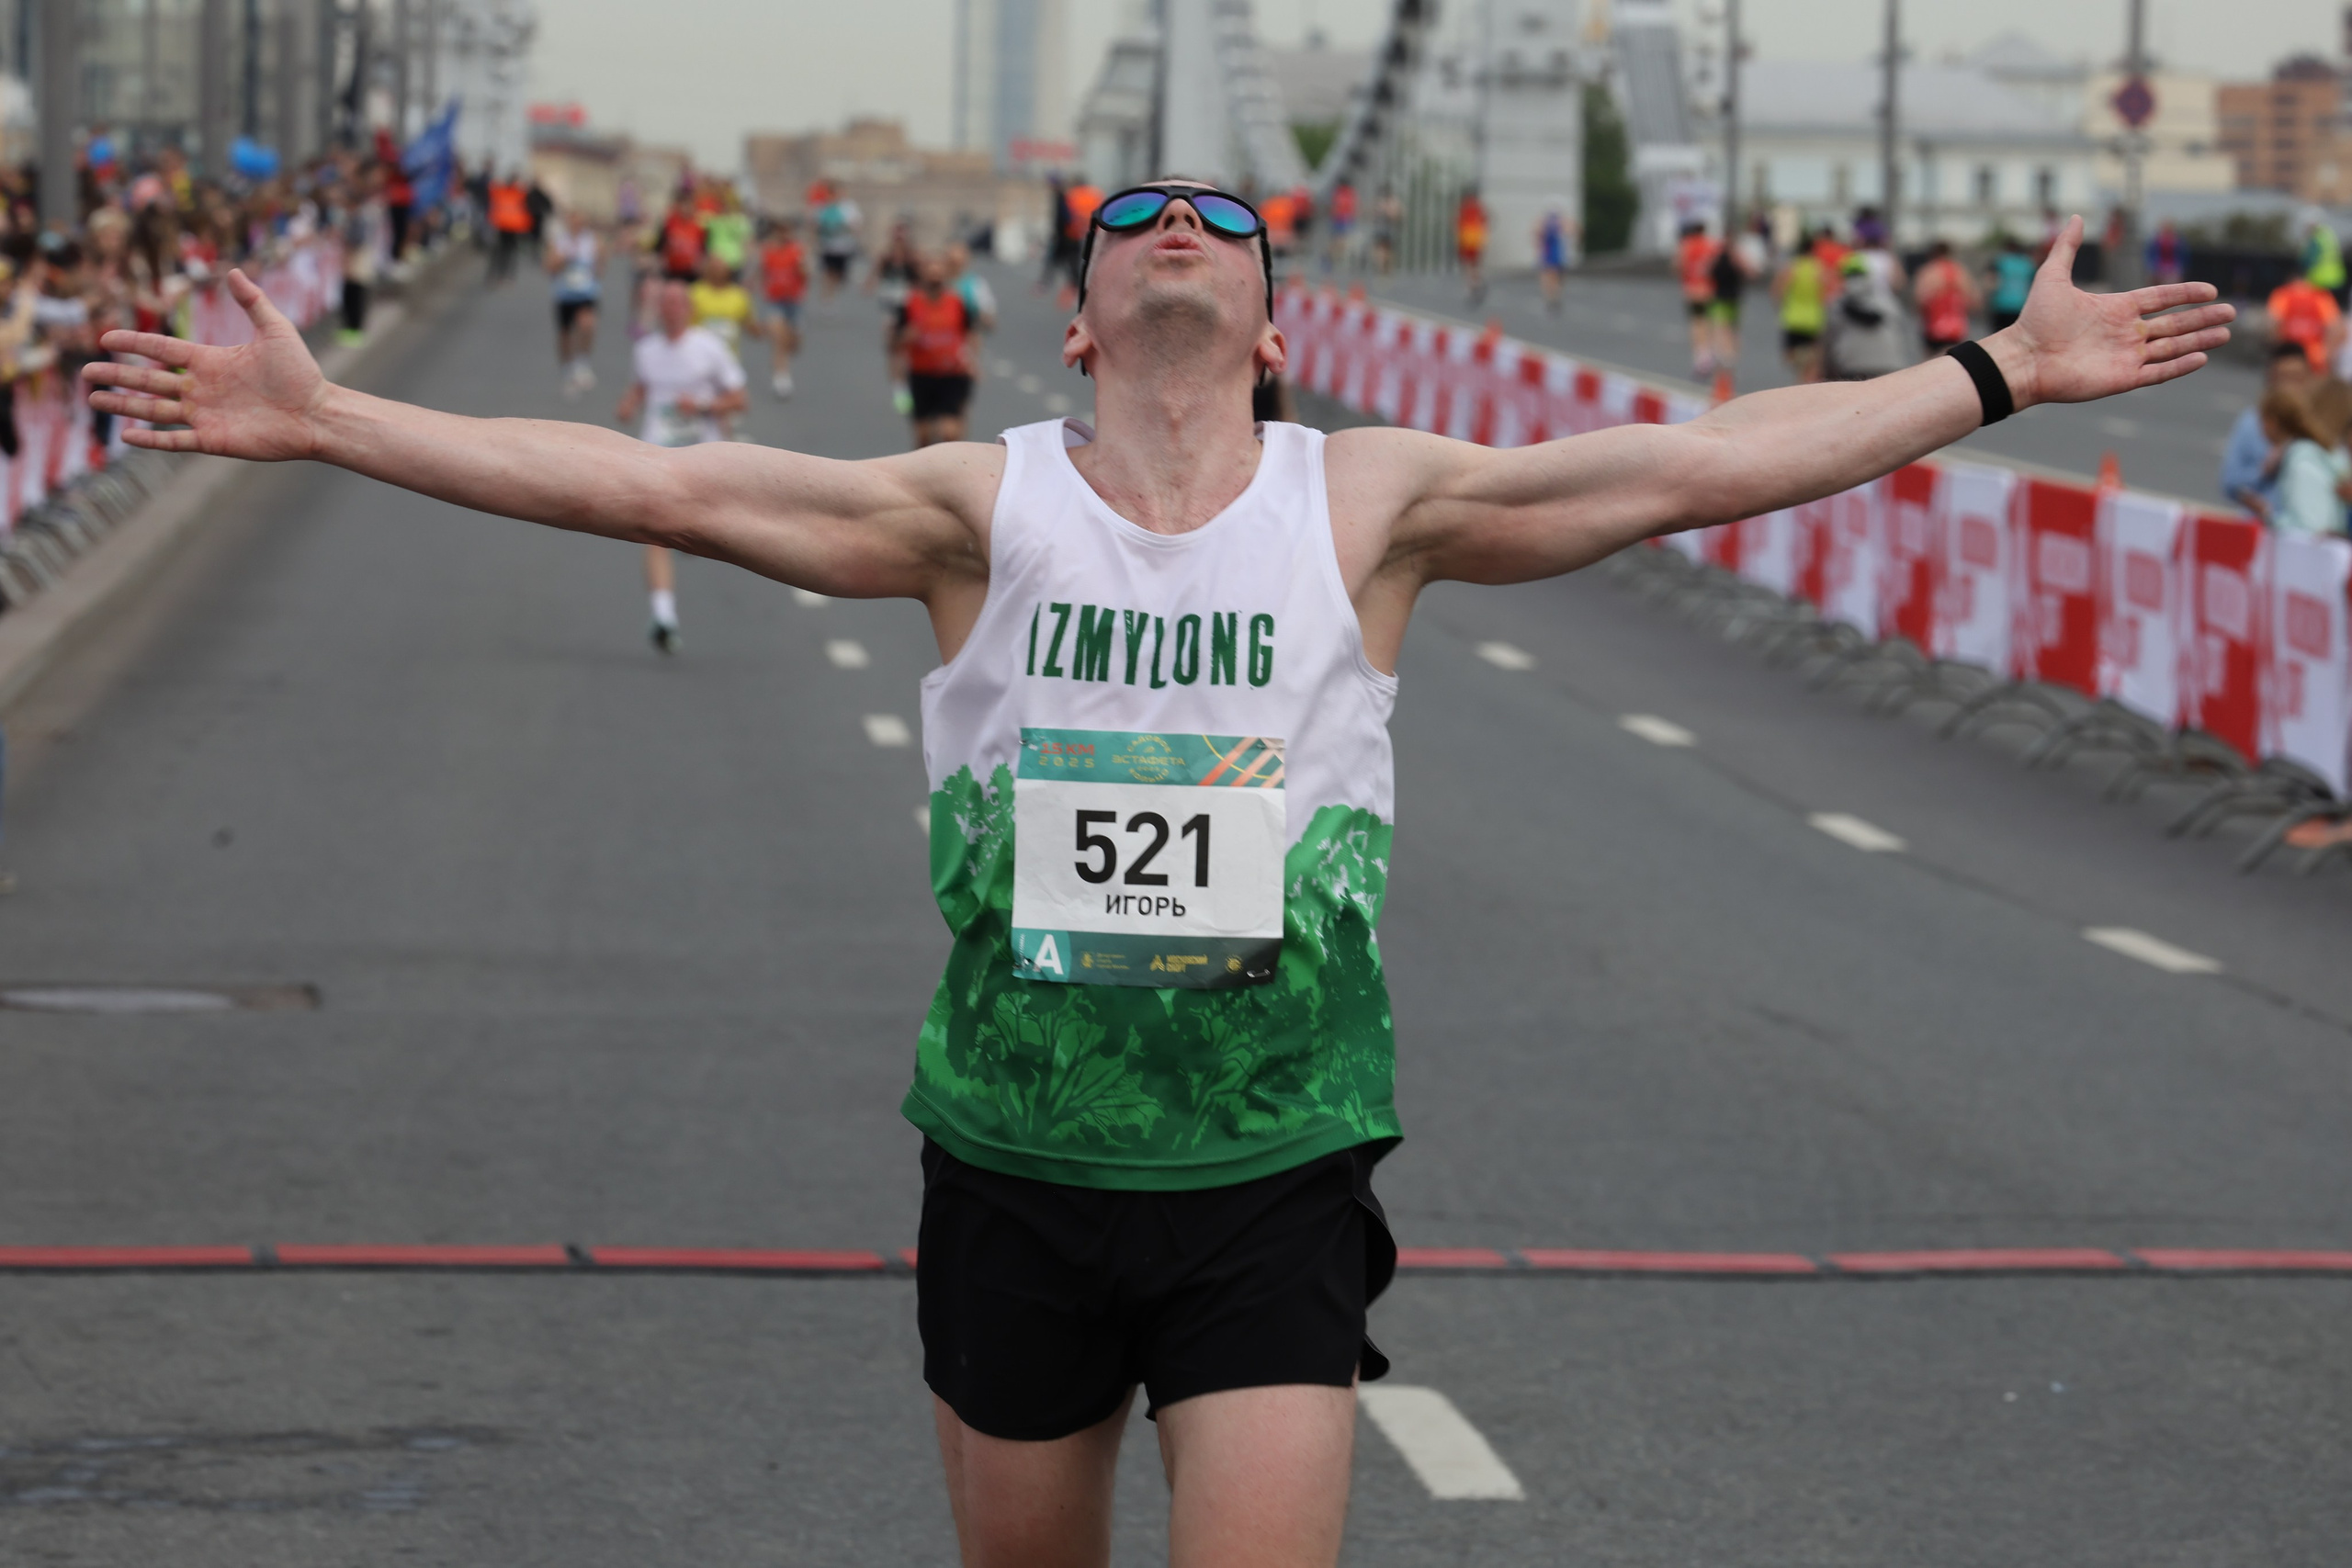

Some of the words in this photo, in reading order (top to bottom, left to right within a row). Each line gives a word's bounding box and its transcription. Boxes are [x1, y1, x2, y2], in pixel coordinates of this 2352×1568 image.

[1026, 602, 1275, 689] IZMYLONG
[1074, 809, 1210, 888] 521
[1105, 894, 1186, 917] ИГОРЬ
